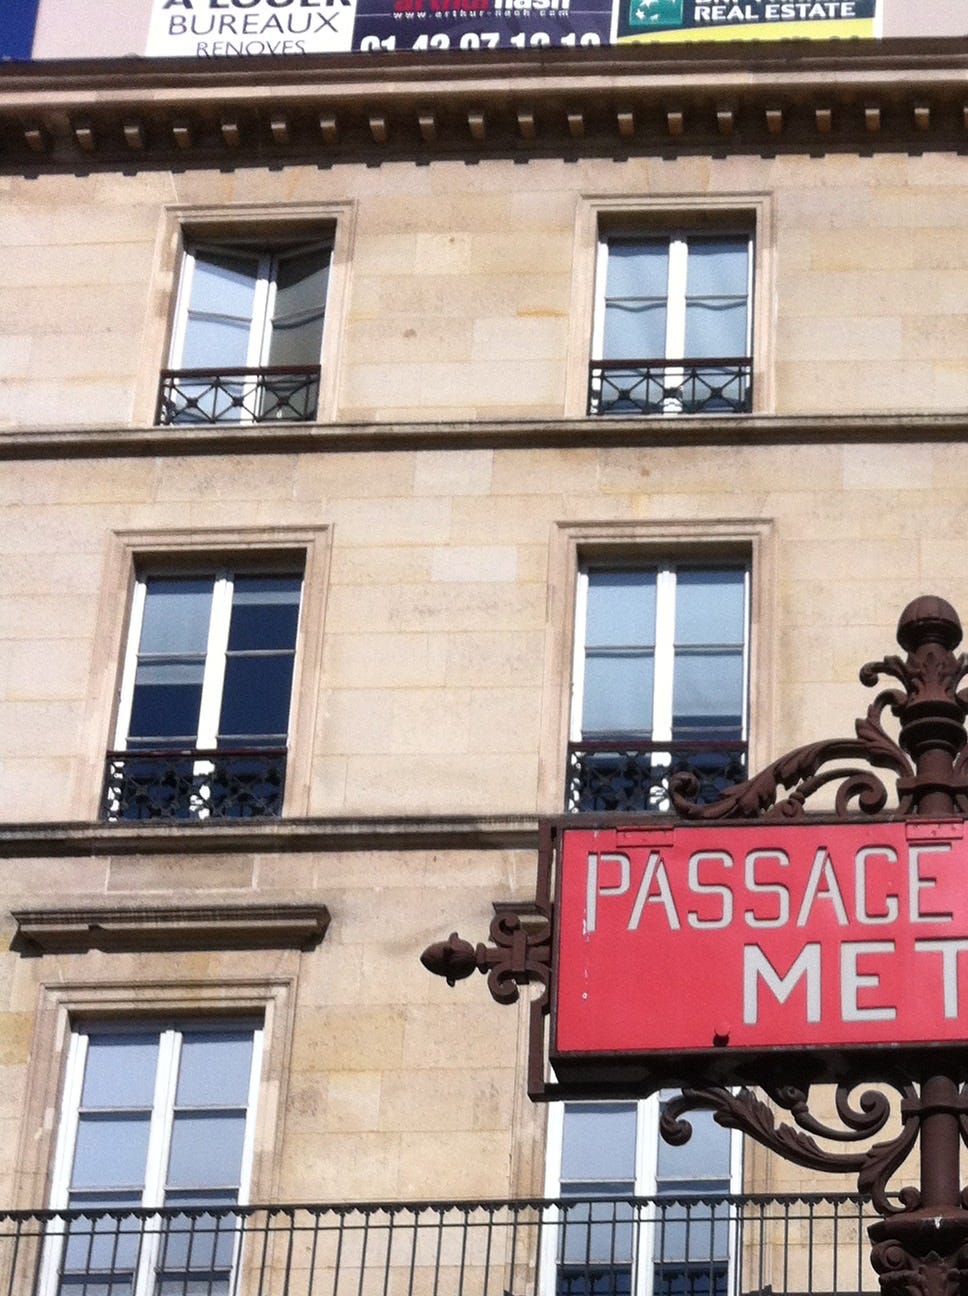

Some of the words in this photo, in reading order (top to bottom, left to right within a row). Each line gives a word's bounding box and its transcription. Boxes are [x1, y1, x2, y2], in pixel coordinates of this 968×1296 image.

[694, 5, 759, 21] REAL
[765, 2, 856, 19] ESTATE
[168, 12, 340, 36] BUREAUX
[585, 843, 953, 931] PASSAGE
